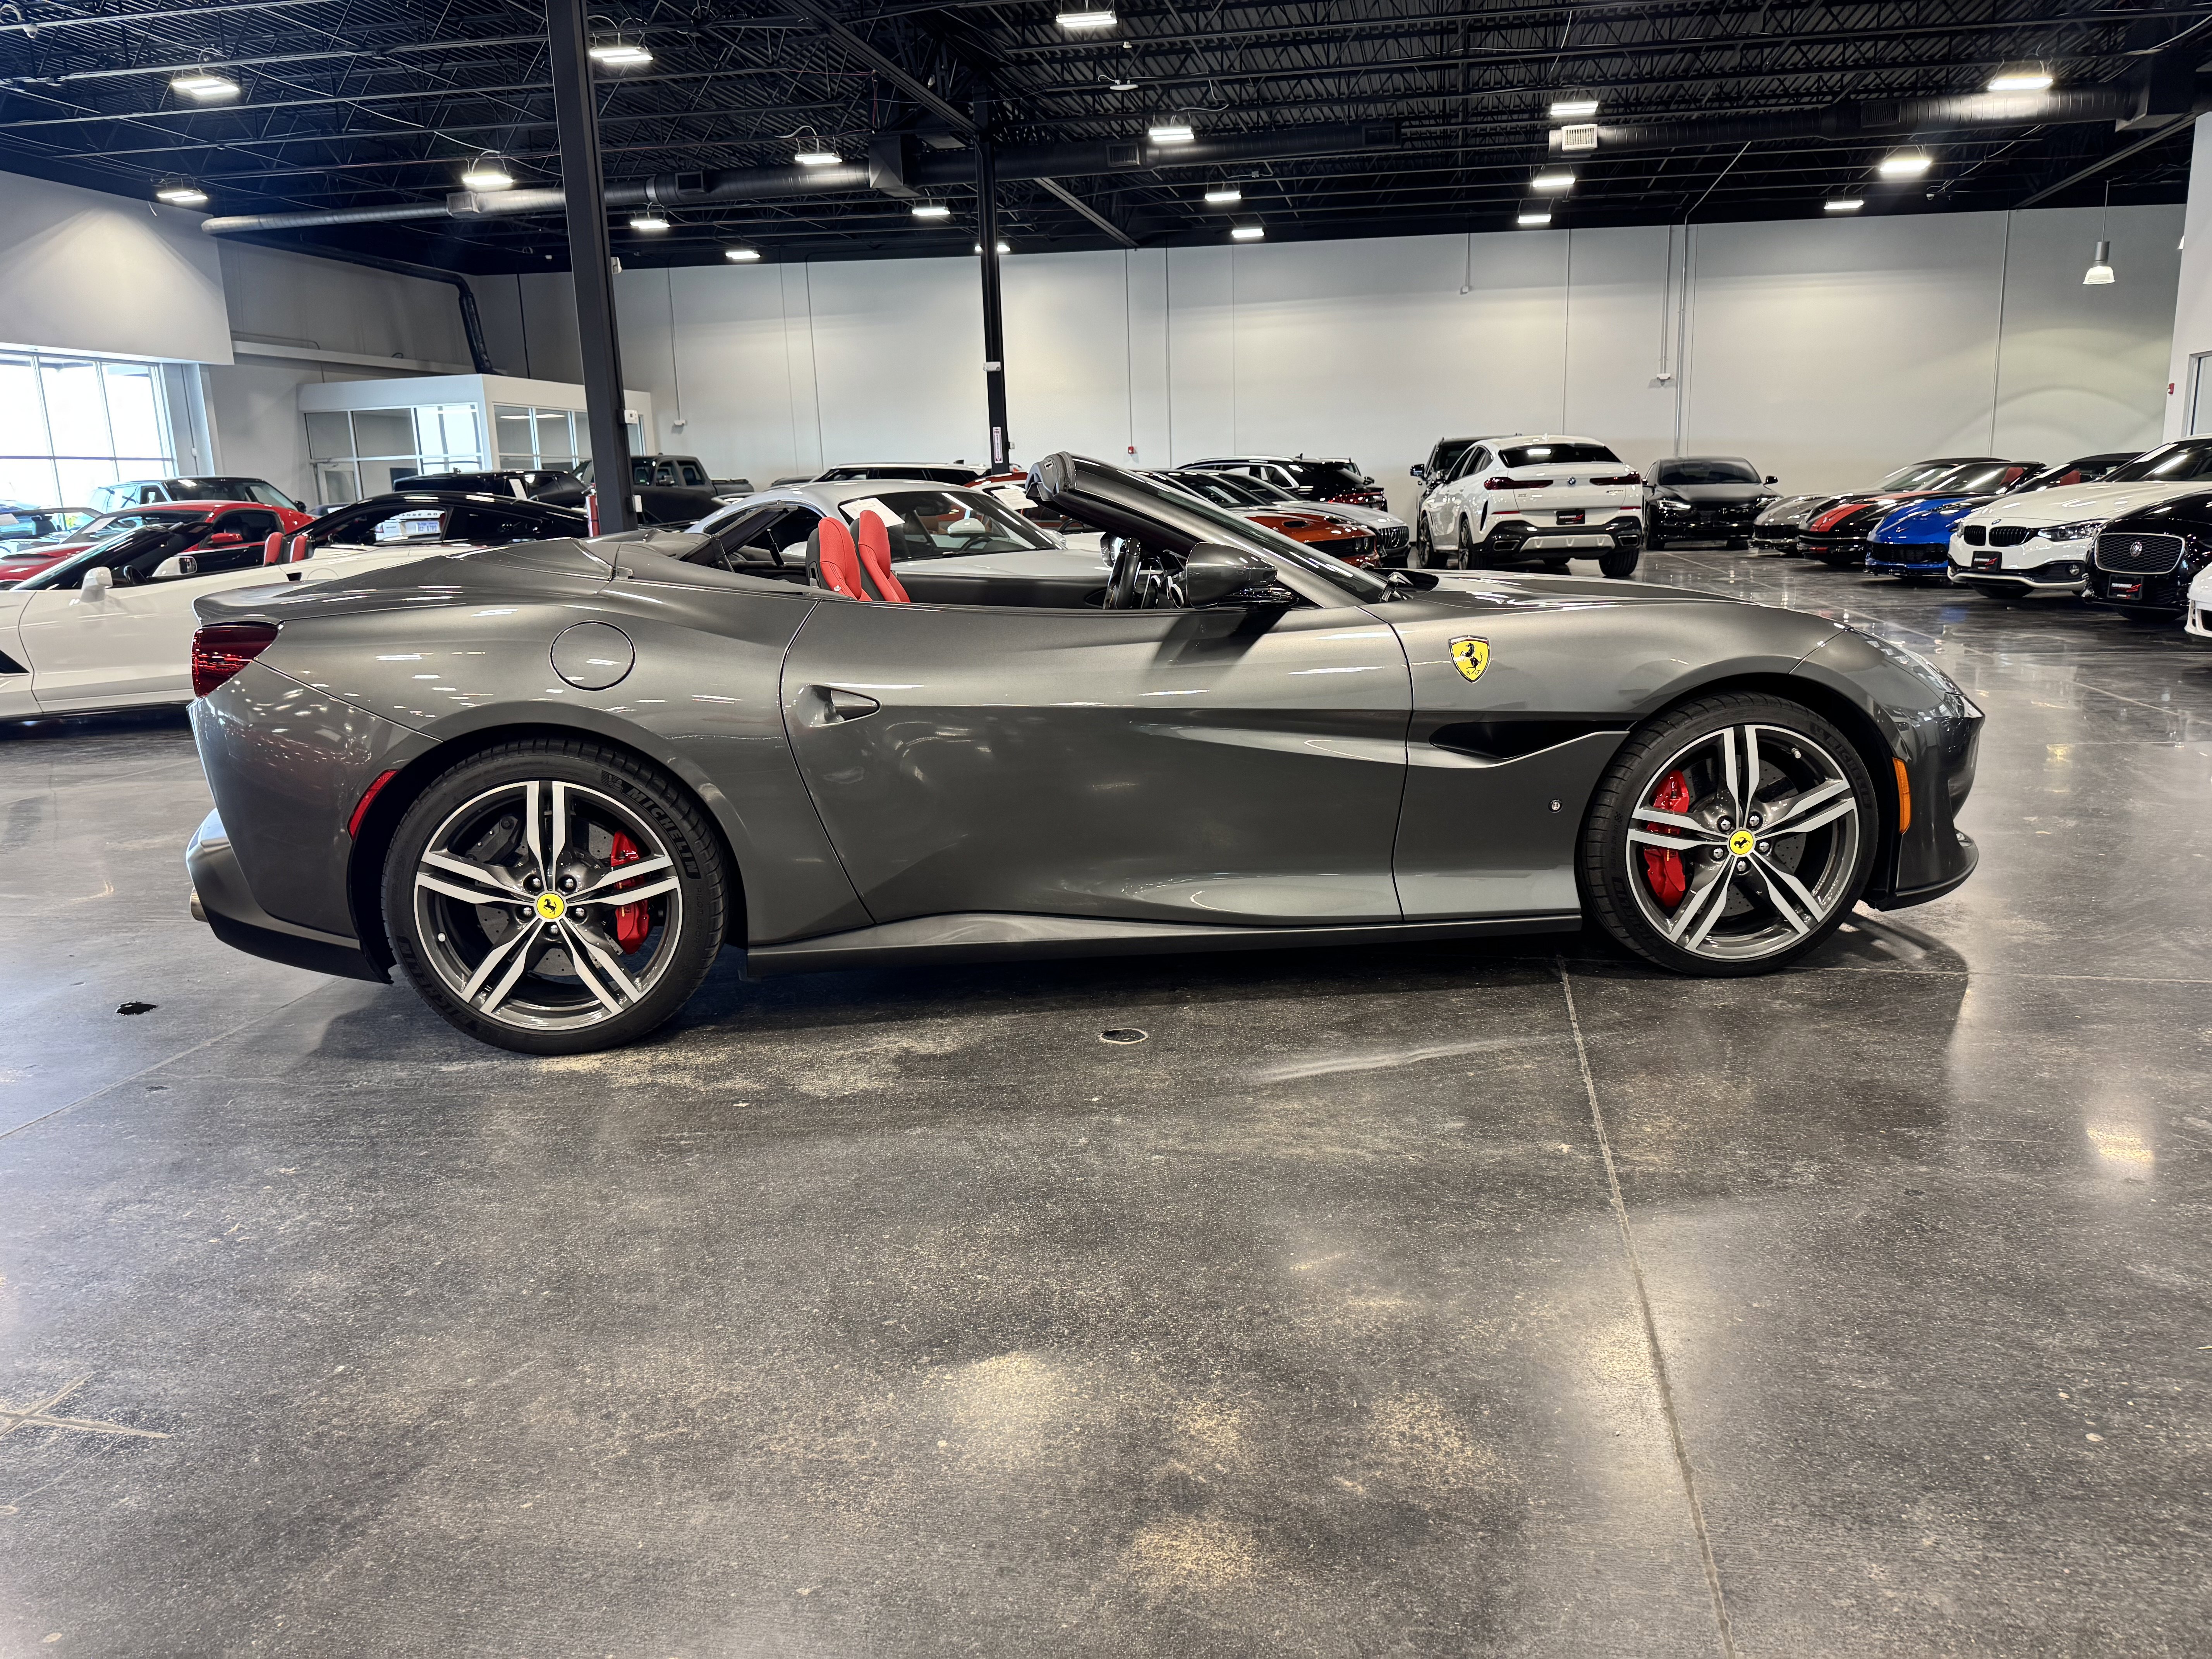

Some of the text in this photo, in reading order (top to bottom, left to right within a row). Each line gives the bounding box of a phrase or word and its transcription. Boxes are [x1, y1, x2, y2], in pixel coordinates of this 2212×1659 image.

[626, 788, 699, 873] MICHELIN
[692, 919, 702, 949] SPORT
[398, 940, 471, 1026] MICHELIN
